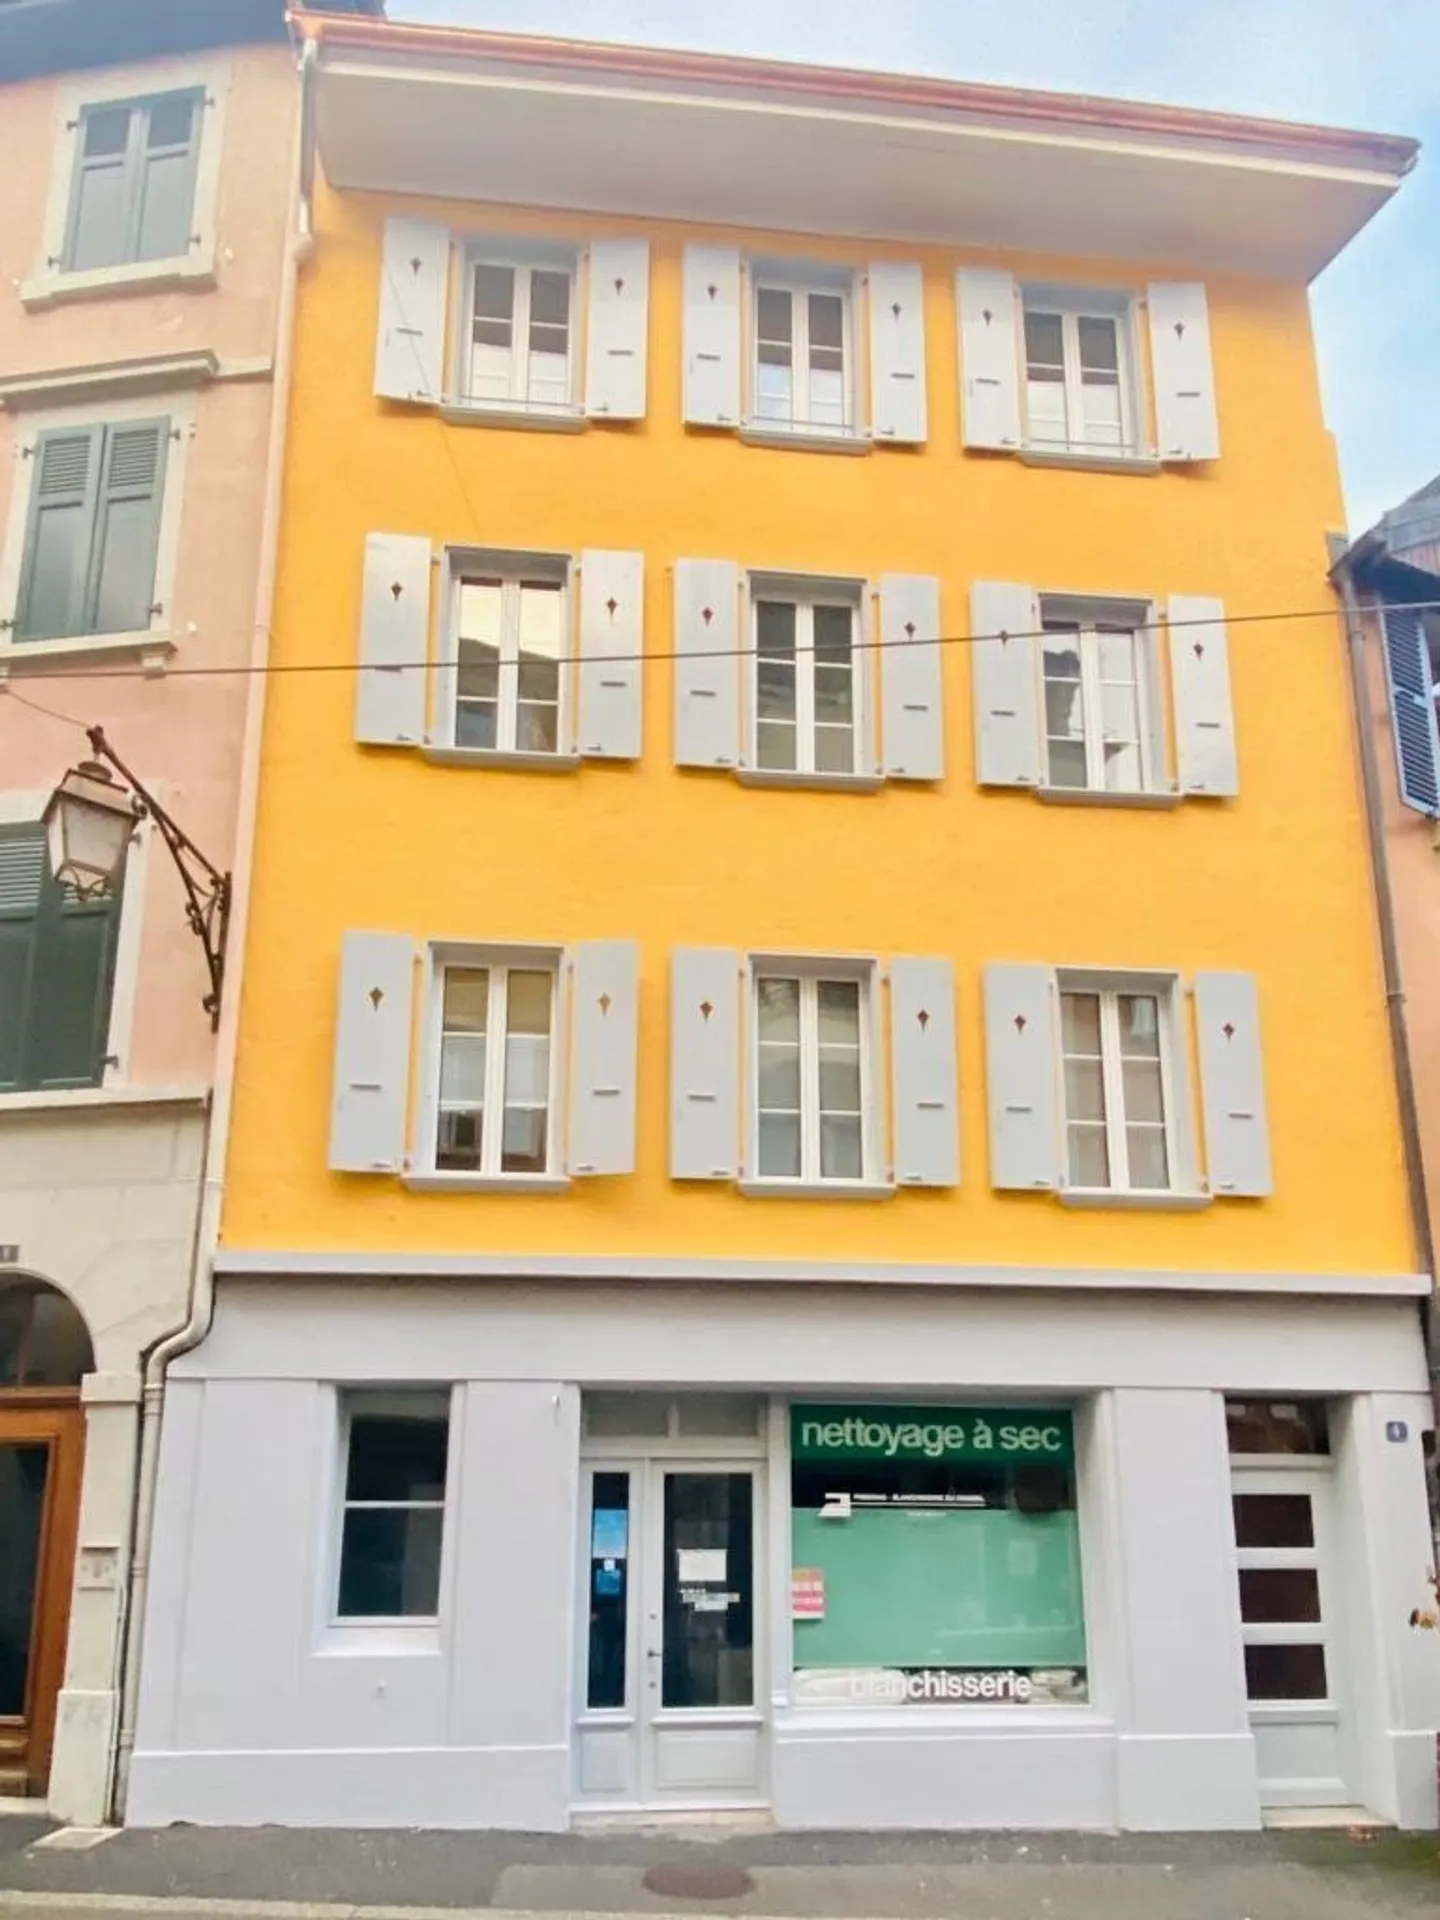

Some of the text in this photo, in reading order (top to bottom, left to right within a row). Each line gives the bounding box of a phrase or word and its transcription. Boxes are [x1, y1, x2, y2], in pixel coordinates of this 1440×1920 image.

[802, 1417, 1062, 1456] nettoyage à sec
[850, 1670, 1032, 1698] blanchisserie
